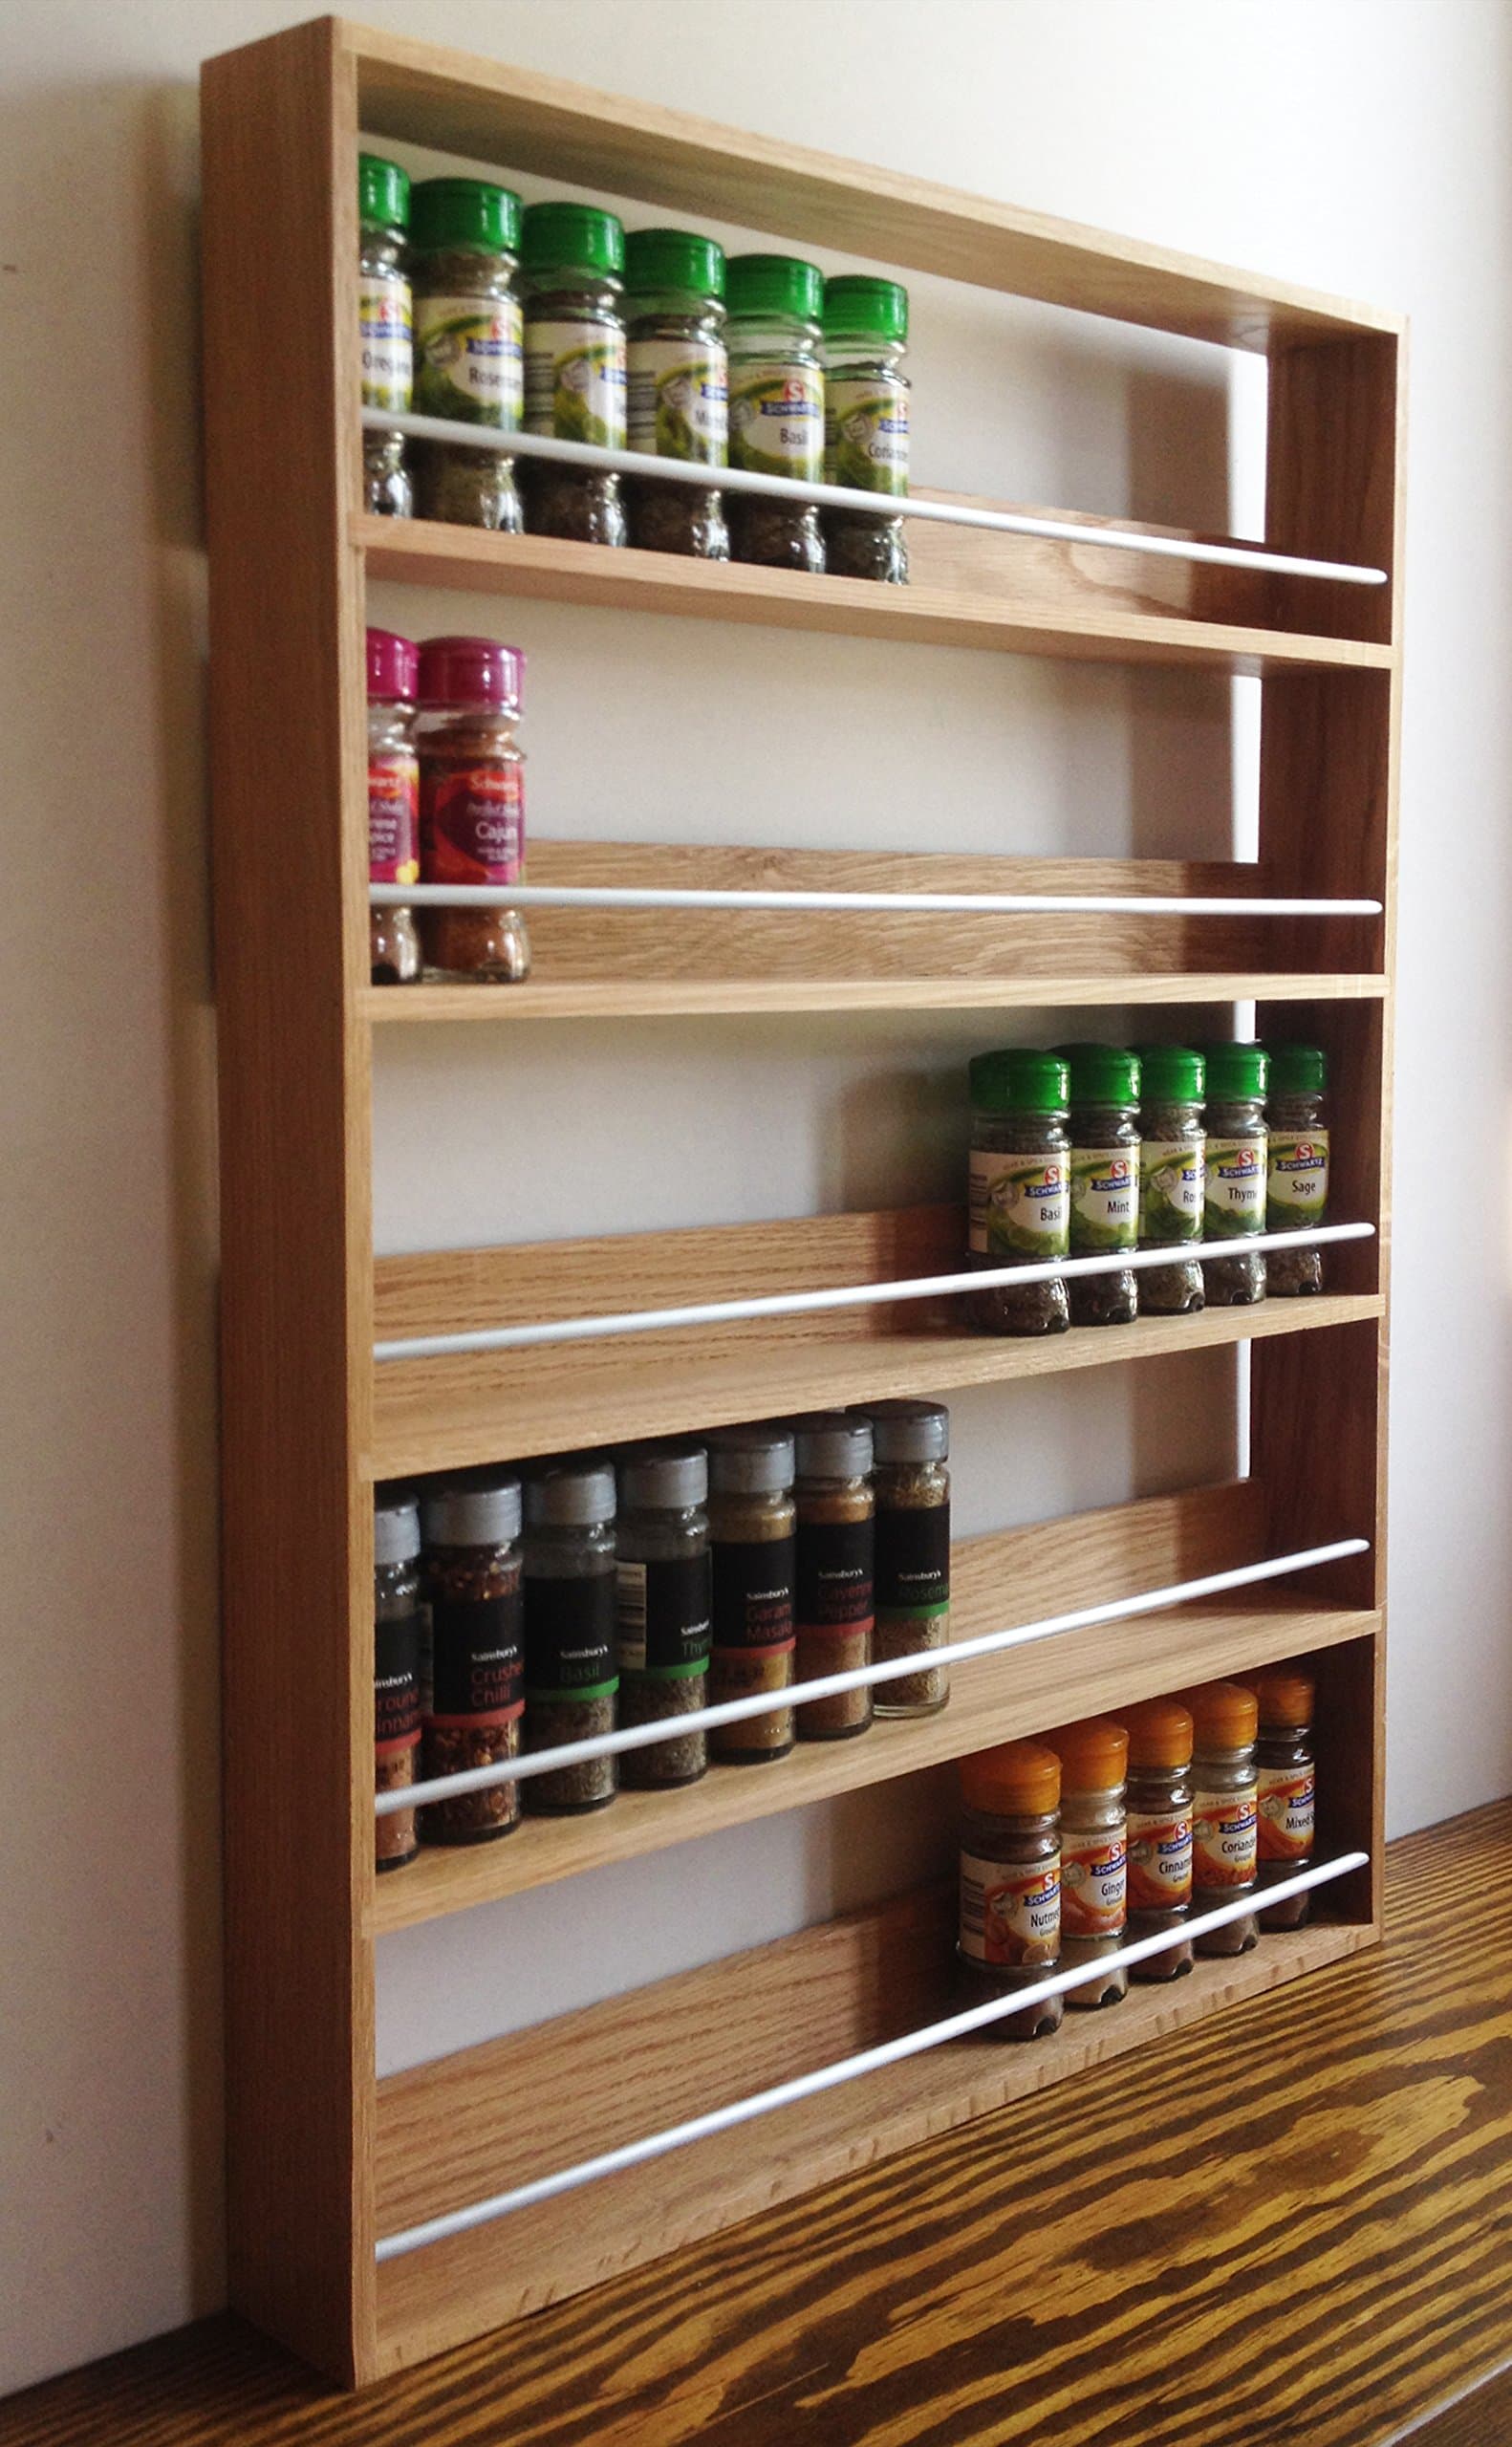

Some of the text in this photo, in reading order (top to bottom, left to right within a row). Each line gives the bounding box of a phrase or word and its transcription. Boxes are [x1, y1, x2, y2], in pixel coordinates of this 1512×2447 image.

[1280, 1158, 1323, 1172] SCHWARTZ
[1292, 1180, 1316, 1196] Sage
[1107, 1201, 1130, 1214] Mint
